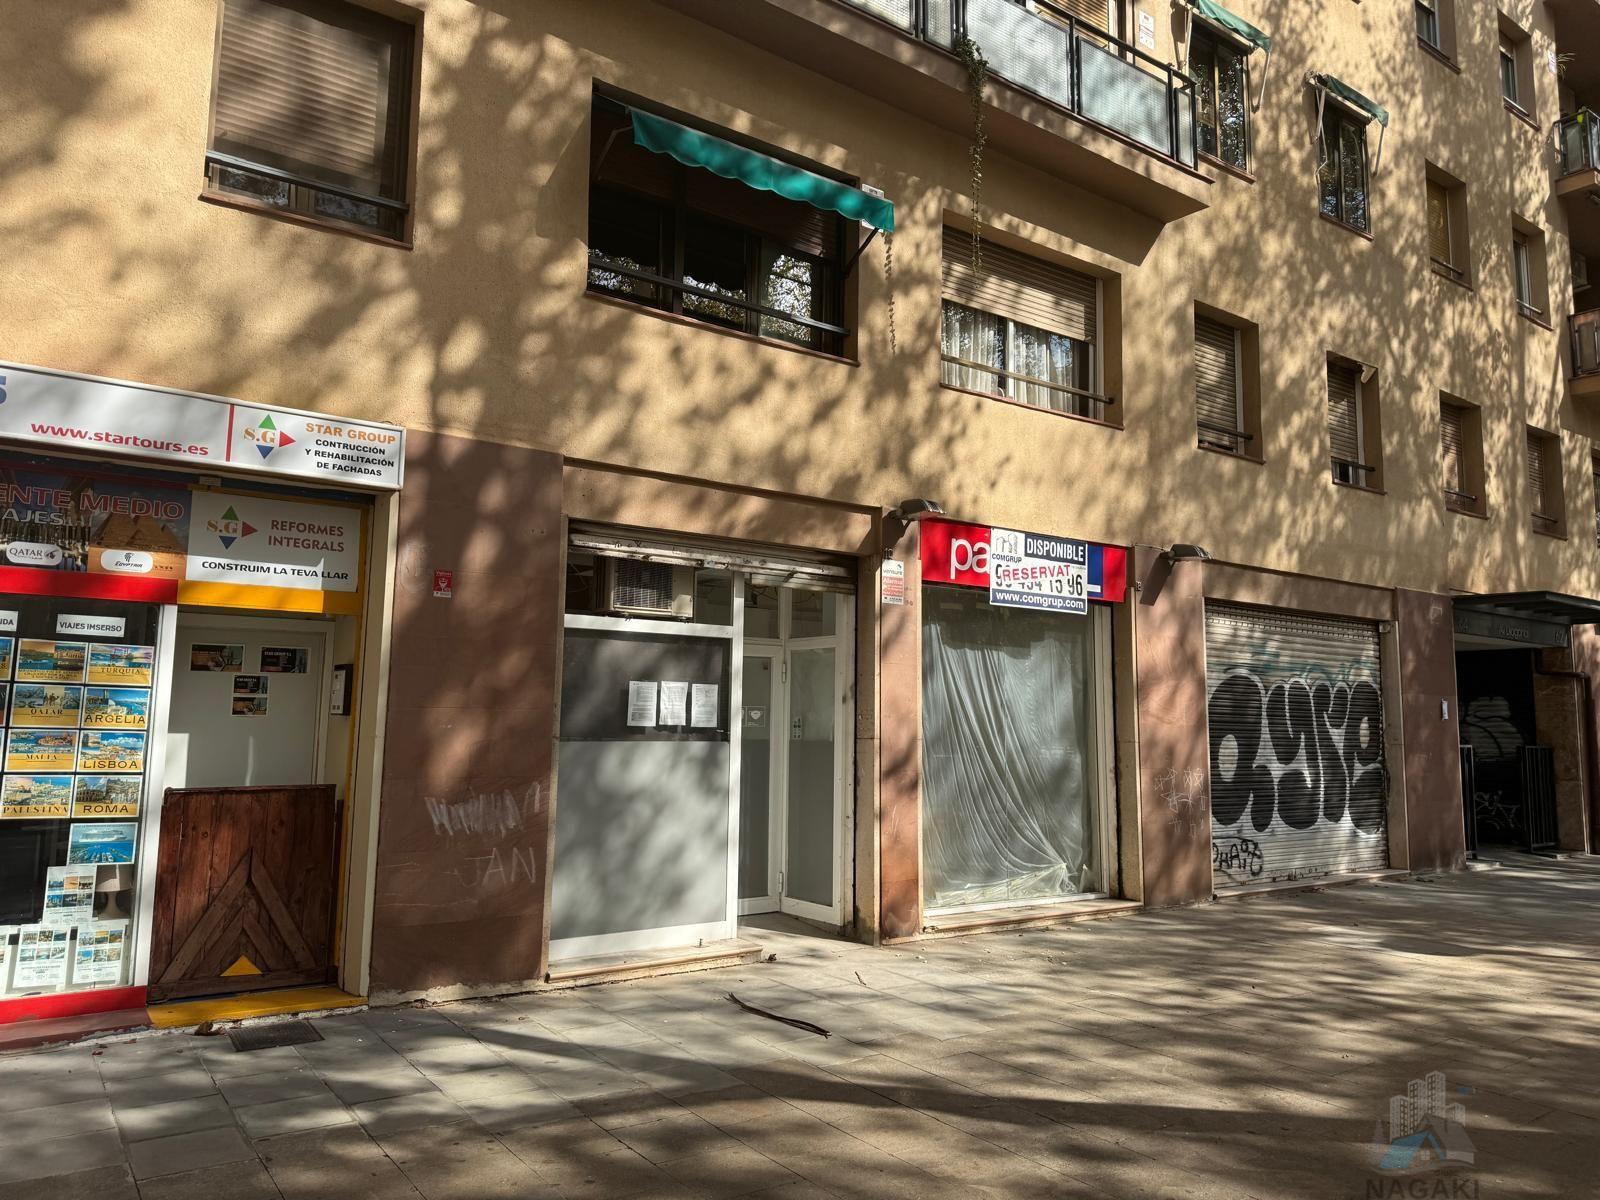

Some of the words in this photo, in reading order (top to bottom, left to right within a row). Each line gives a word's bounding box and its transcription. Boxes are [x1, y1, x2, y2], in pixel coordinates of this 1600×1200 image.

[31, 423, 208, 456] www.startours.es
[243, 427, 276, 444] S.G
[306, 422, 342, 438] STAR
[348, 429, 396, 444] GROUP
[315, 438, 386, 455] CONTRUCCIÓN
[314, 450, 394, 467] REHABILITACIÓN
[316, 462, 329, 470] DE
[332, 464, 382, 476] FACHADAS
[80, 492, 184, 520] MEDIO
[206, 520, 238, 534] S.G
[271, 519, 344, 537] REFORMES
[10, 548, 42, 556] QATAR
[268, 536, 344, 552] INTEGRALS
[1026, 538, 1084, 562] DISPONIBLE
[992, 553, 1022, 563] COMGRUP
[202, 561, 270, 574] CONSTRUIM
[274, 566, 288, 575] LA
[290, 568, 318, 578] TEVA
[321, 570, 348, 580] LLAR
[1002, 564, 1070, 581] RESERVAT
[995, 592, 1084, 608] www.comgrup.com
[60, 622, 86, 630] VIAJES
[86, 624, 122, 632] IMSERSO
[84, 715, 146, 724] ARGELIA
[83, 760, 138, 769] LISBOA
[83, 805, 128, 814] ROMA
